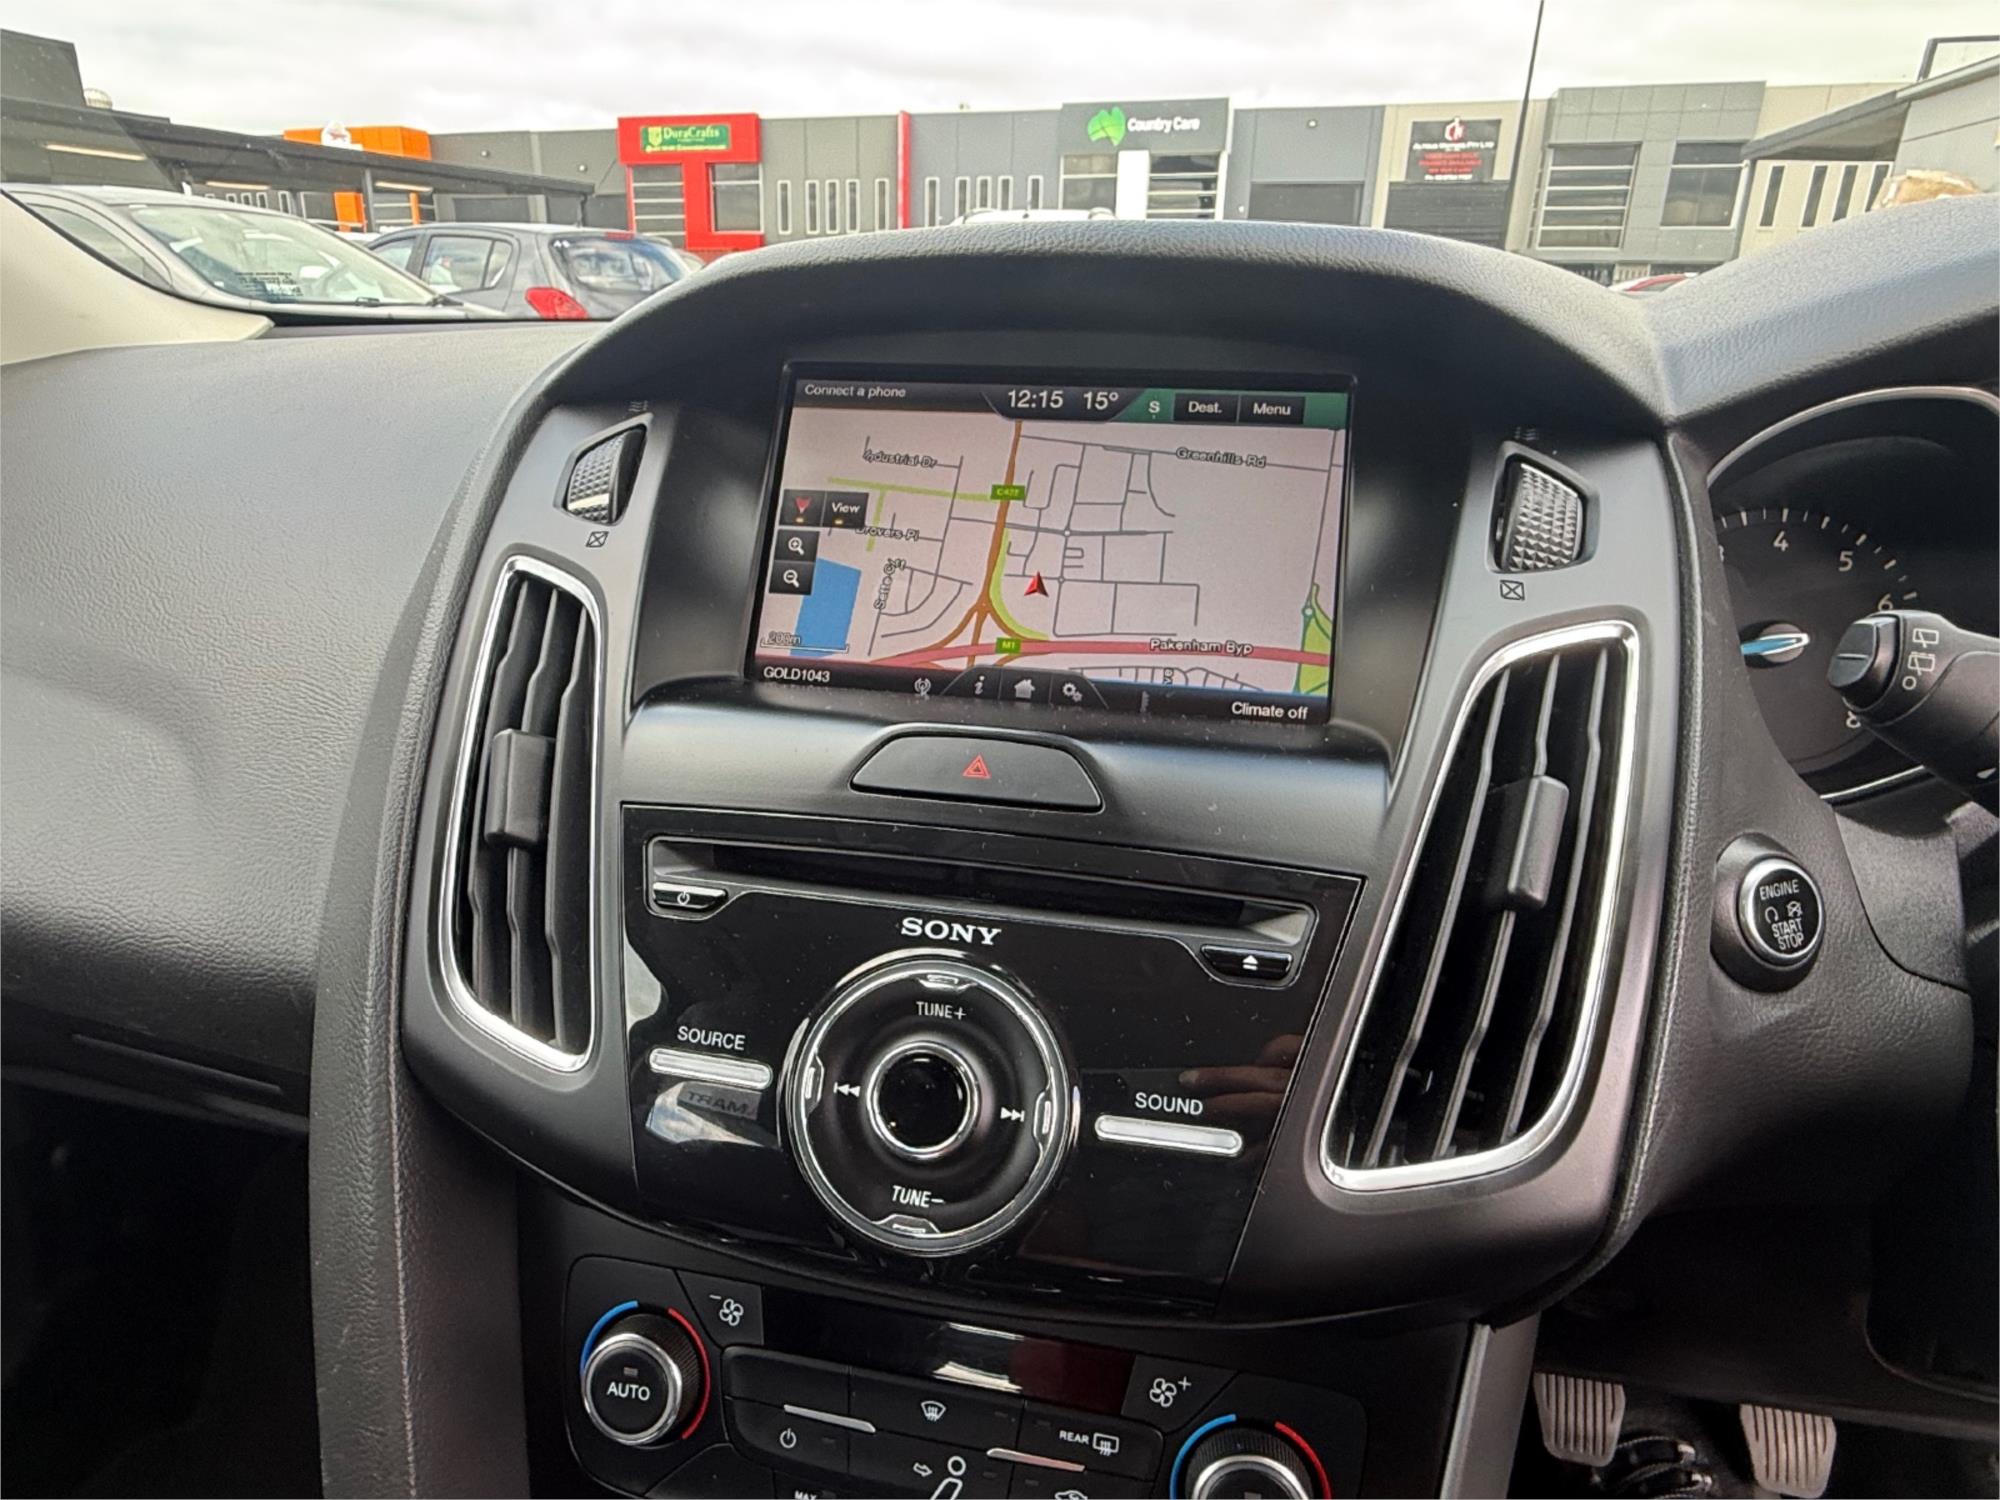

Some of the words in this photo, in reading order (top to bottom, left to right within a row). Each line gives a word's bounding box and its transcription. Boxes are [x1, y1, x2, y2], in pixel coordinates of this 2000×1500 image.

[663, 126, 720, 139] DuraCrafts
[1127, 117, 1172, 133] Country
[1173, 116, 1200, 130] Care
[804, 383, 854, 397] Connect
[857, 388, 865, 397] a
[868, 386, 907, 399] phone
[1008, 389, 1064, 409] 12:15
[1148, 401, 1160, 414] S
[1188, 401, 1222, 414] Dest.
[1253, 402, 1291, 416] Menu
[920, 455, 938, 468] Dr
[1176, 447, 1243, 465] Greenhills
[1245, 454, 1267, 468] Rd
[832, 502, 860, 514] View
[1773, 530, 1789, 552] 4
[1839, 551, 1854, 572] 5
[1878, 593, 1894, 612] 6
[1002, 641, 1016, 650] M1
[1150, 638, 1223, 653] Pakenham
[1225, 640, 1254, 657] Byp
[1231, 701, 1285, 718] Climate
[1287, 706, 1309, 720] off
[1759, 879, 1800, 900] ENGINE
[901, 917, 1002, 945] SONY
[1771, 918, 1803, 938] START
[1777, 932, 1804, 950] STOP
[677, 1025, 746, 1051] SOURCE
[1135, 1091, 1204, 1115] SOUND
[606, 1381, 651, 1401] AUTO
[1059, 1429, 1090, 1445] REAR
